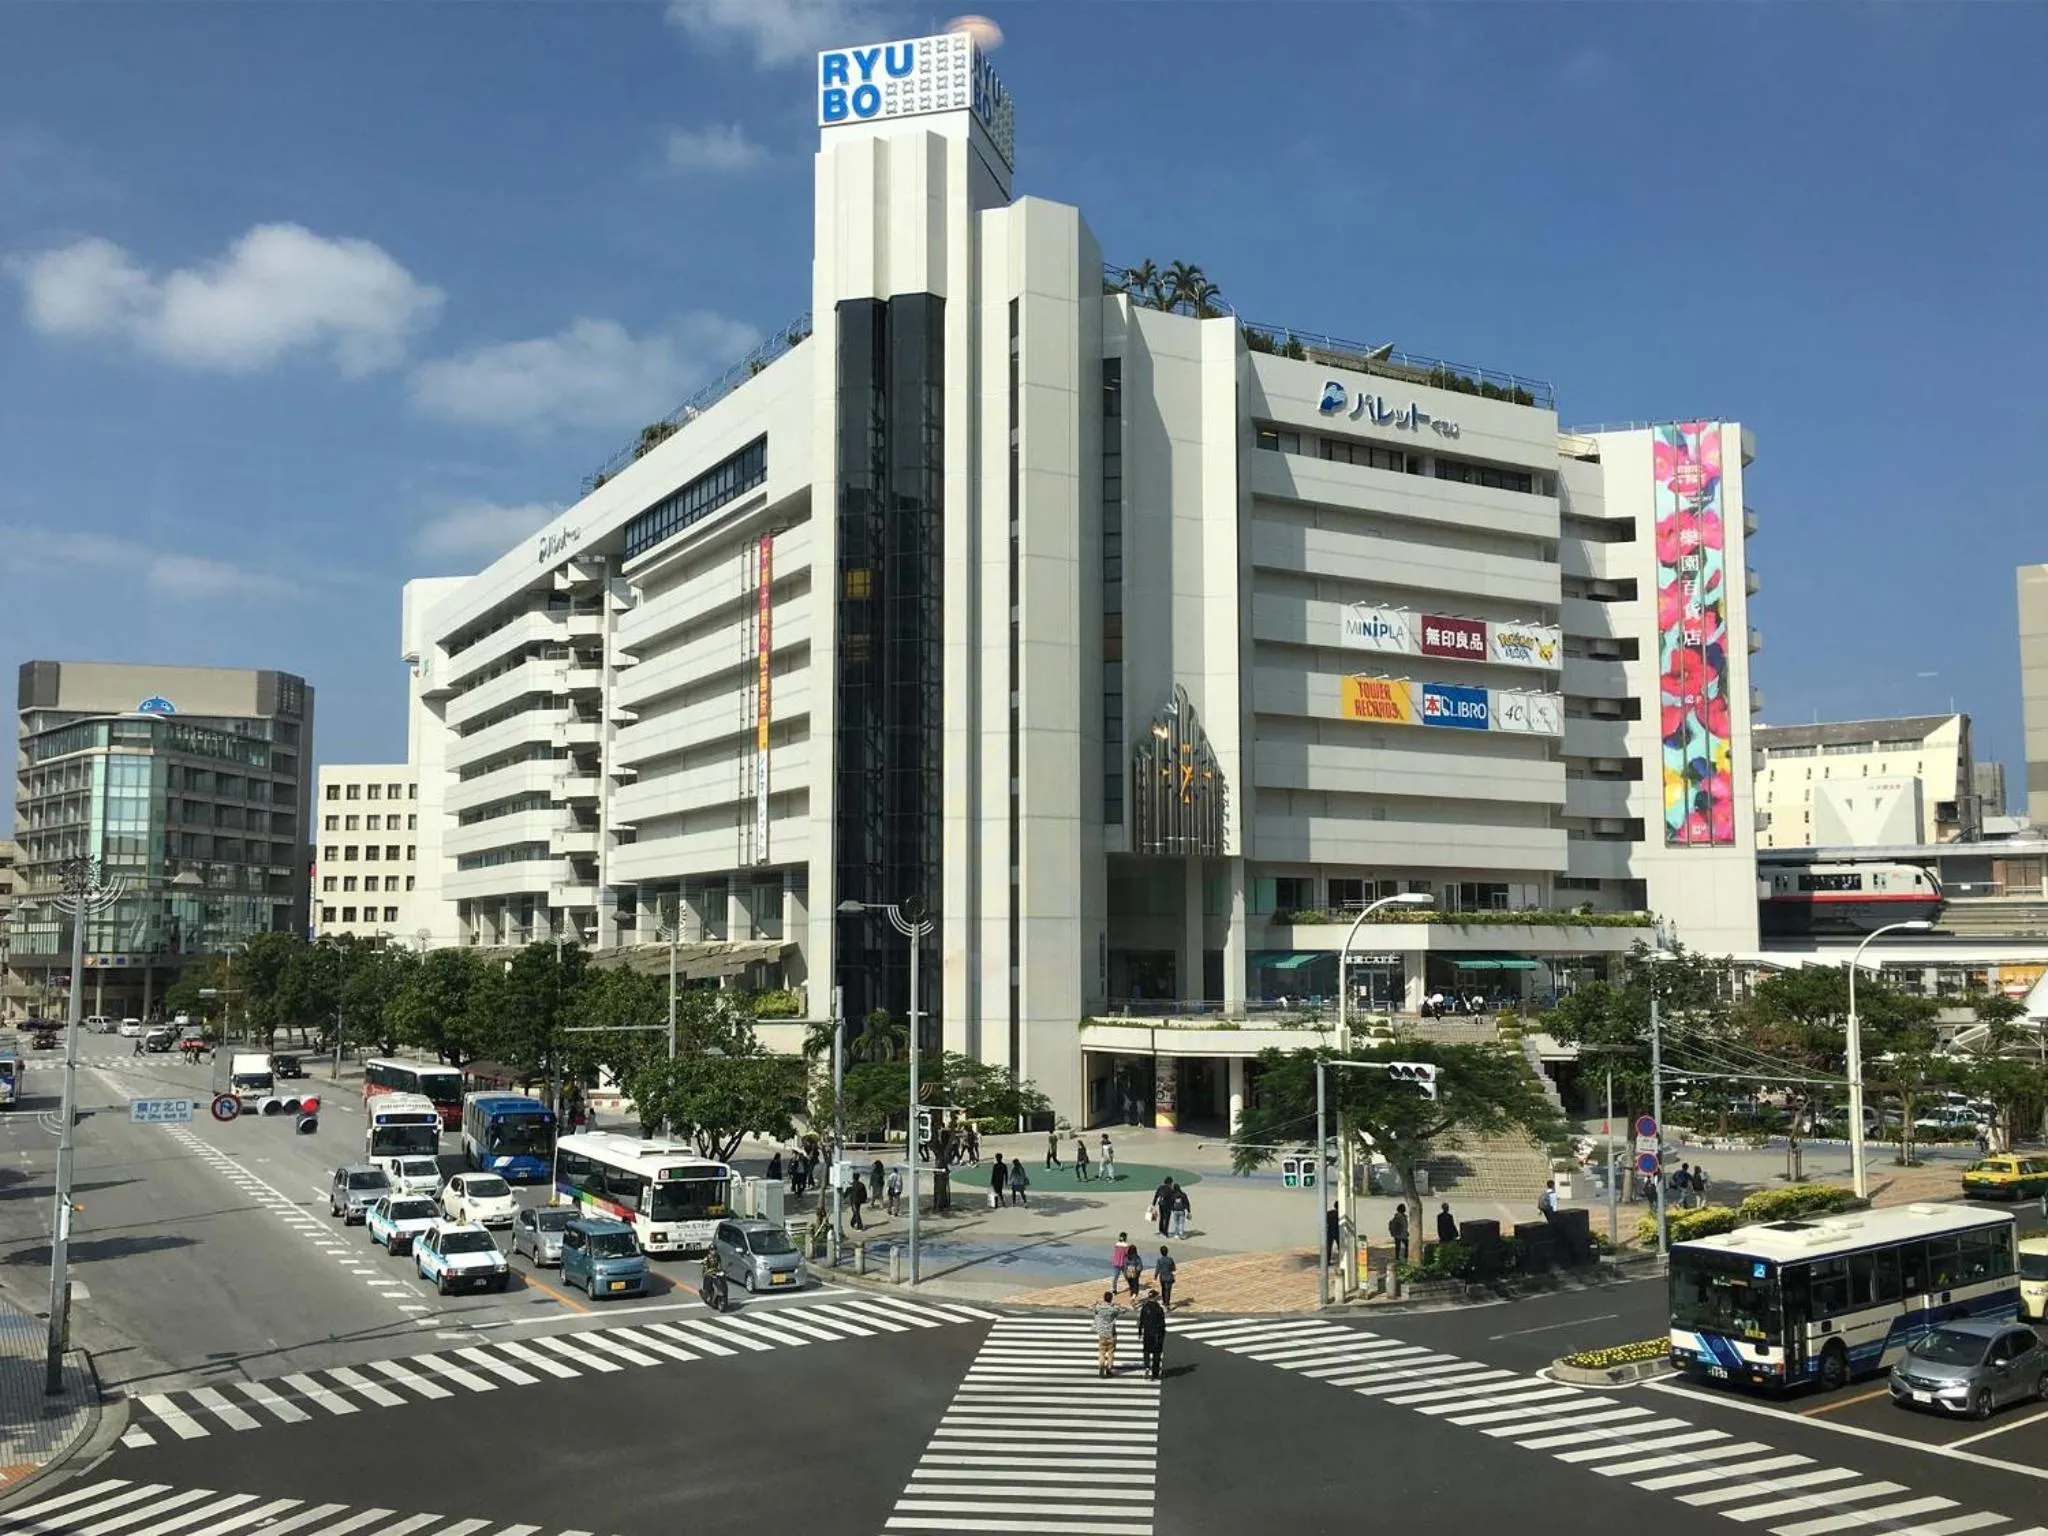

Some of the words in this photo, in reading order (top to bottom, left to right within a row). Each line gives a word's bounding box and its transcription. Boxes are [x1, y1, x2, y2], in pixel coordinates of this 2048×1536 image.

[823, 43, 914, 87] RYU
[823, 84, 881, 122] BO
[1426, 627, 1484, 652] 無印良品
[1359, 682, 1392, 701] TOWER
[1355, 699, 1401, 719] RECORDS
[1450, 700, 1487, 719] LIBRO
